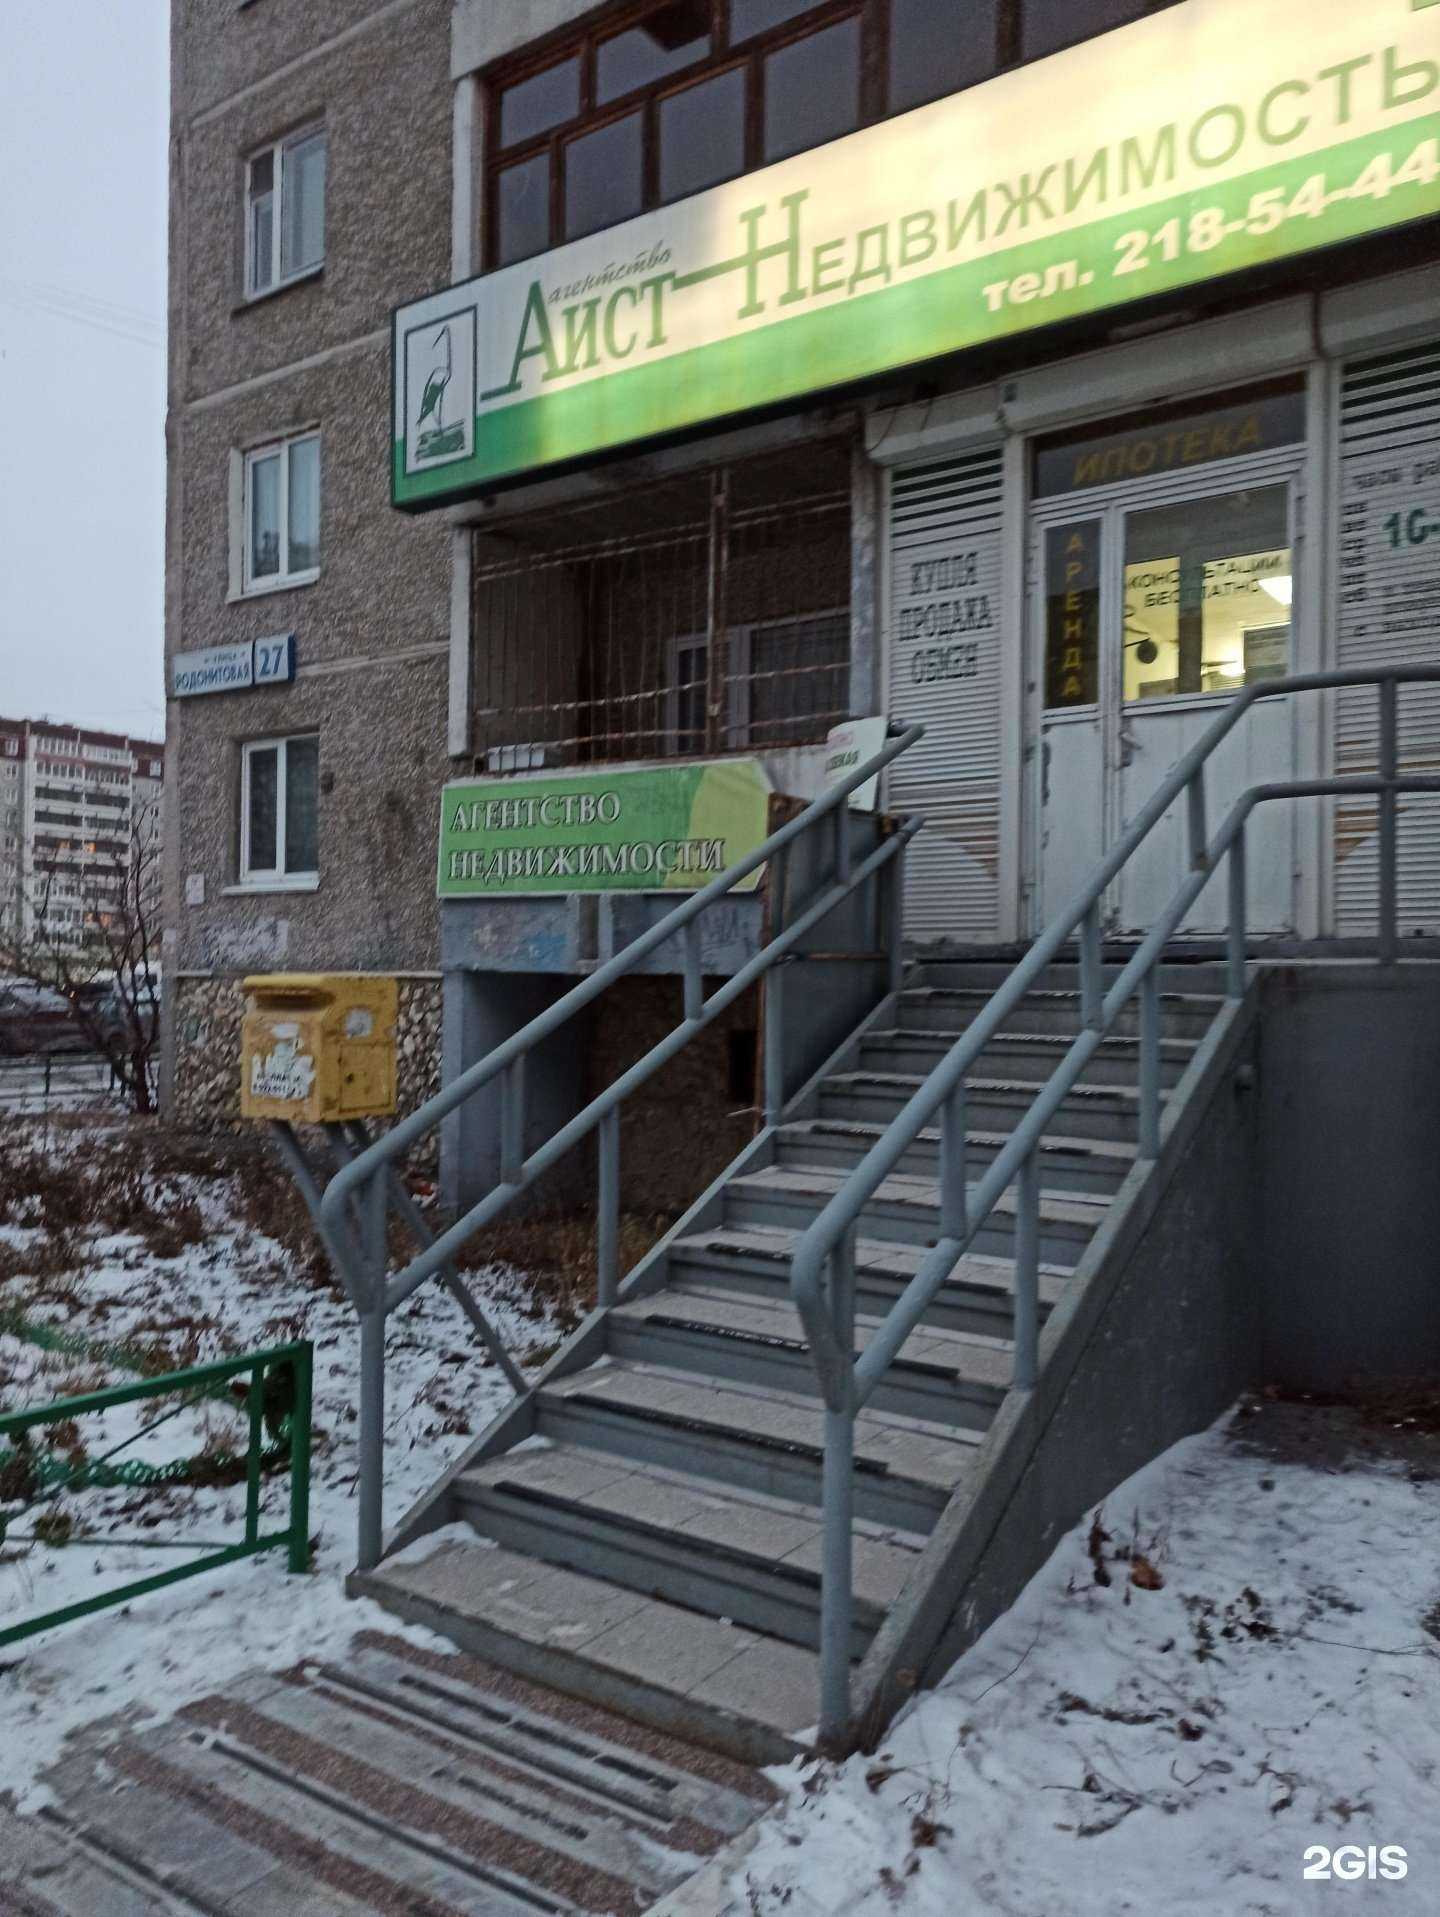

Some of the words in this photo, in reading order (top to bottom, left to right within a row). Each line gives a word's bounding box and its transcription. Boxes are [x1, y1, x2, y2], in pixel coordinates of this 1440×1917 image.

[982, 258, 1094, 312] тел.
[1112, 138, 1440, 277] 218-54-44
[547, 239, 673, 304] агентство
[1072, 415, 1262, 487] ИПОТЕКА
[899, 595, 993, 641] ПРОДАЖА
[1063, 531, 1083, 697] АРЕНДА
[260, 644, 284, 676] 27
[450, 791, 621, 833] АГЕНТСТВО
[448, 837, 725, 886] НЕДВИЖИМОСТИ
